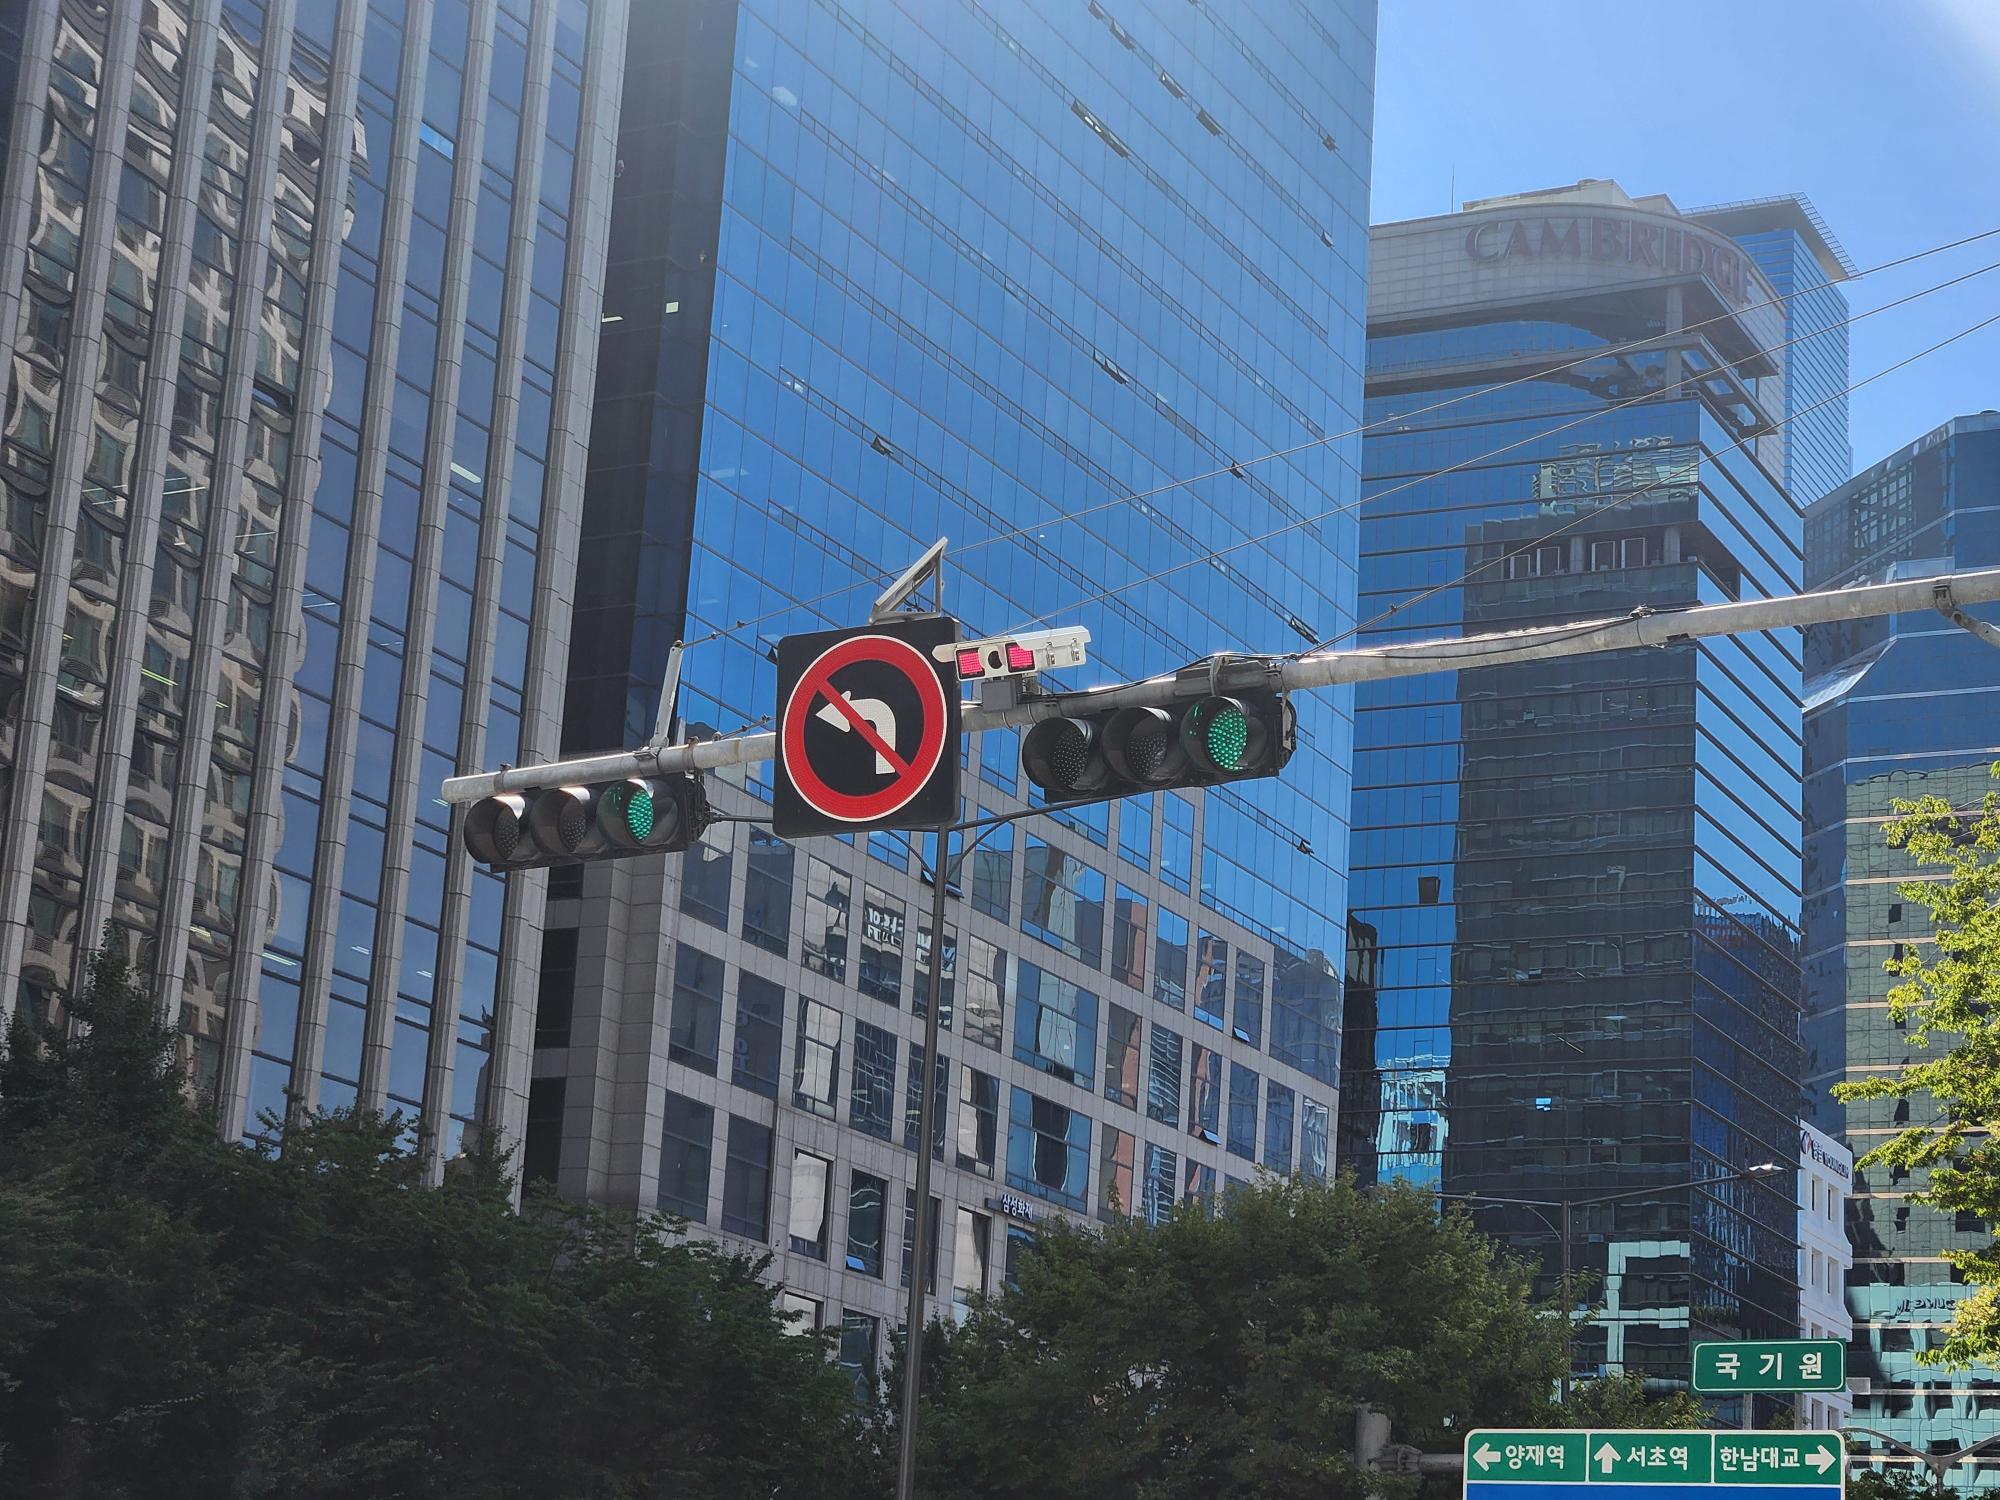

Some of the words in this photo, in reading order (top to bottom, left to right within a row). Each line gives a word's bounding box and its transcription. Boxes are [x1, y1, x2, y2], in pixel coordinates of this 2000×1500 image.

[1465, 216, 1753, 305] CAMBRIDGE
[1002, 1193, 1033, 1220] 삼성화재
[1714, 1351, 1823, 1381] 국기원
[1504, 1443, 1566, 1470] 양재역
[1626, 1445, 1689, 1472] 서초역
[1719, 1446, 1801, 1472] 한남대교
